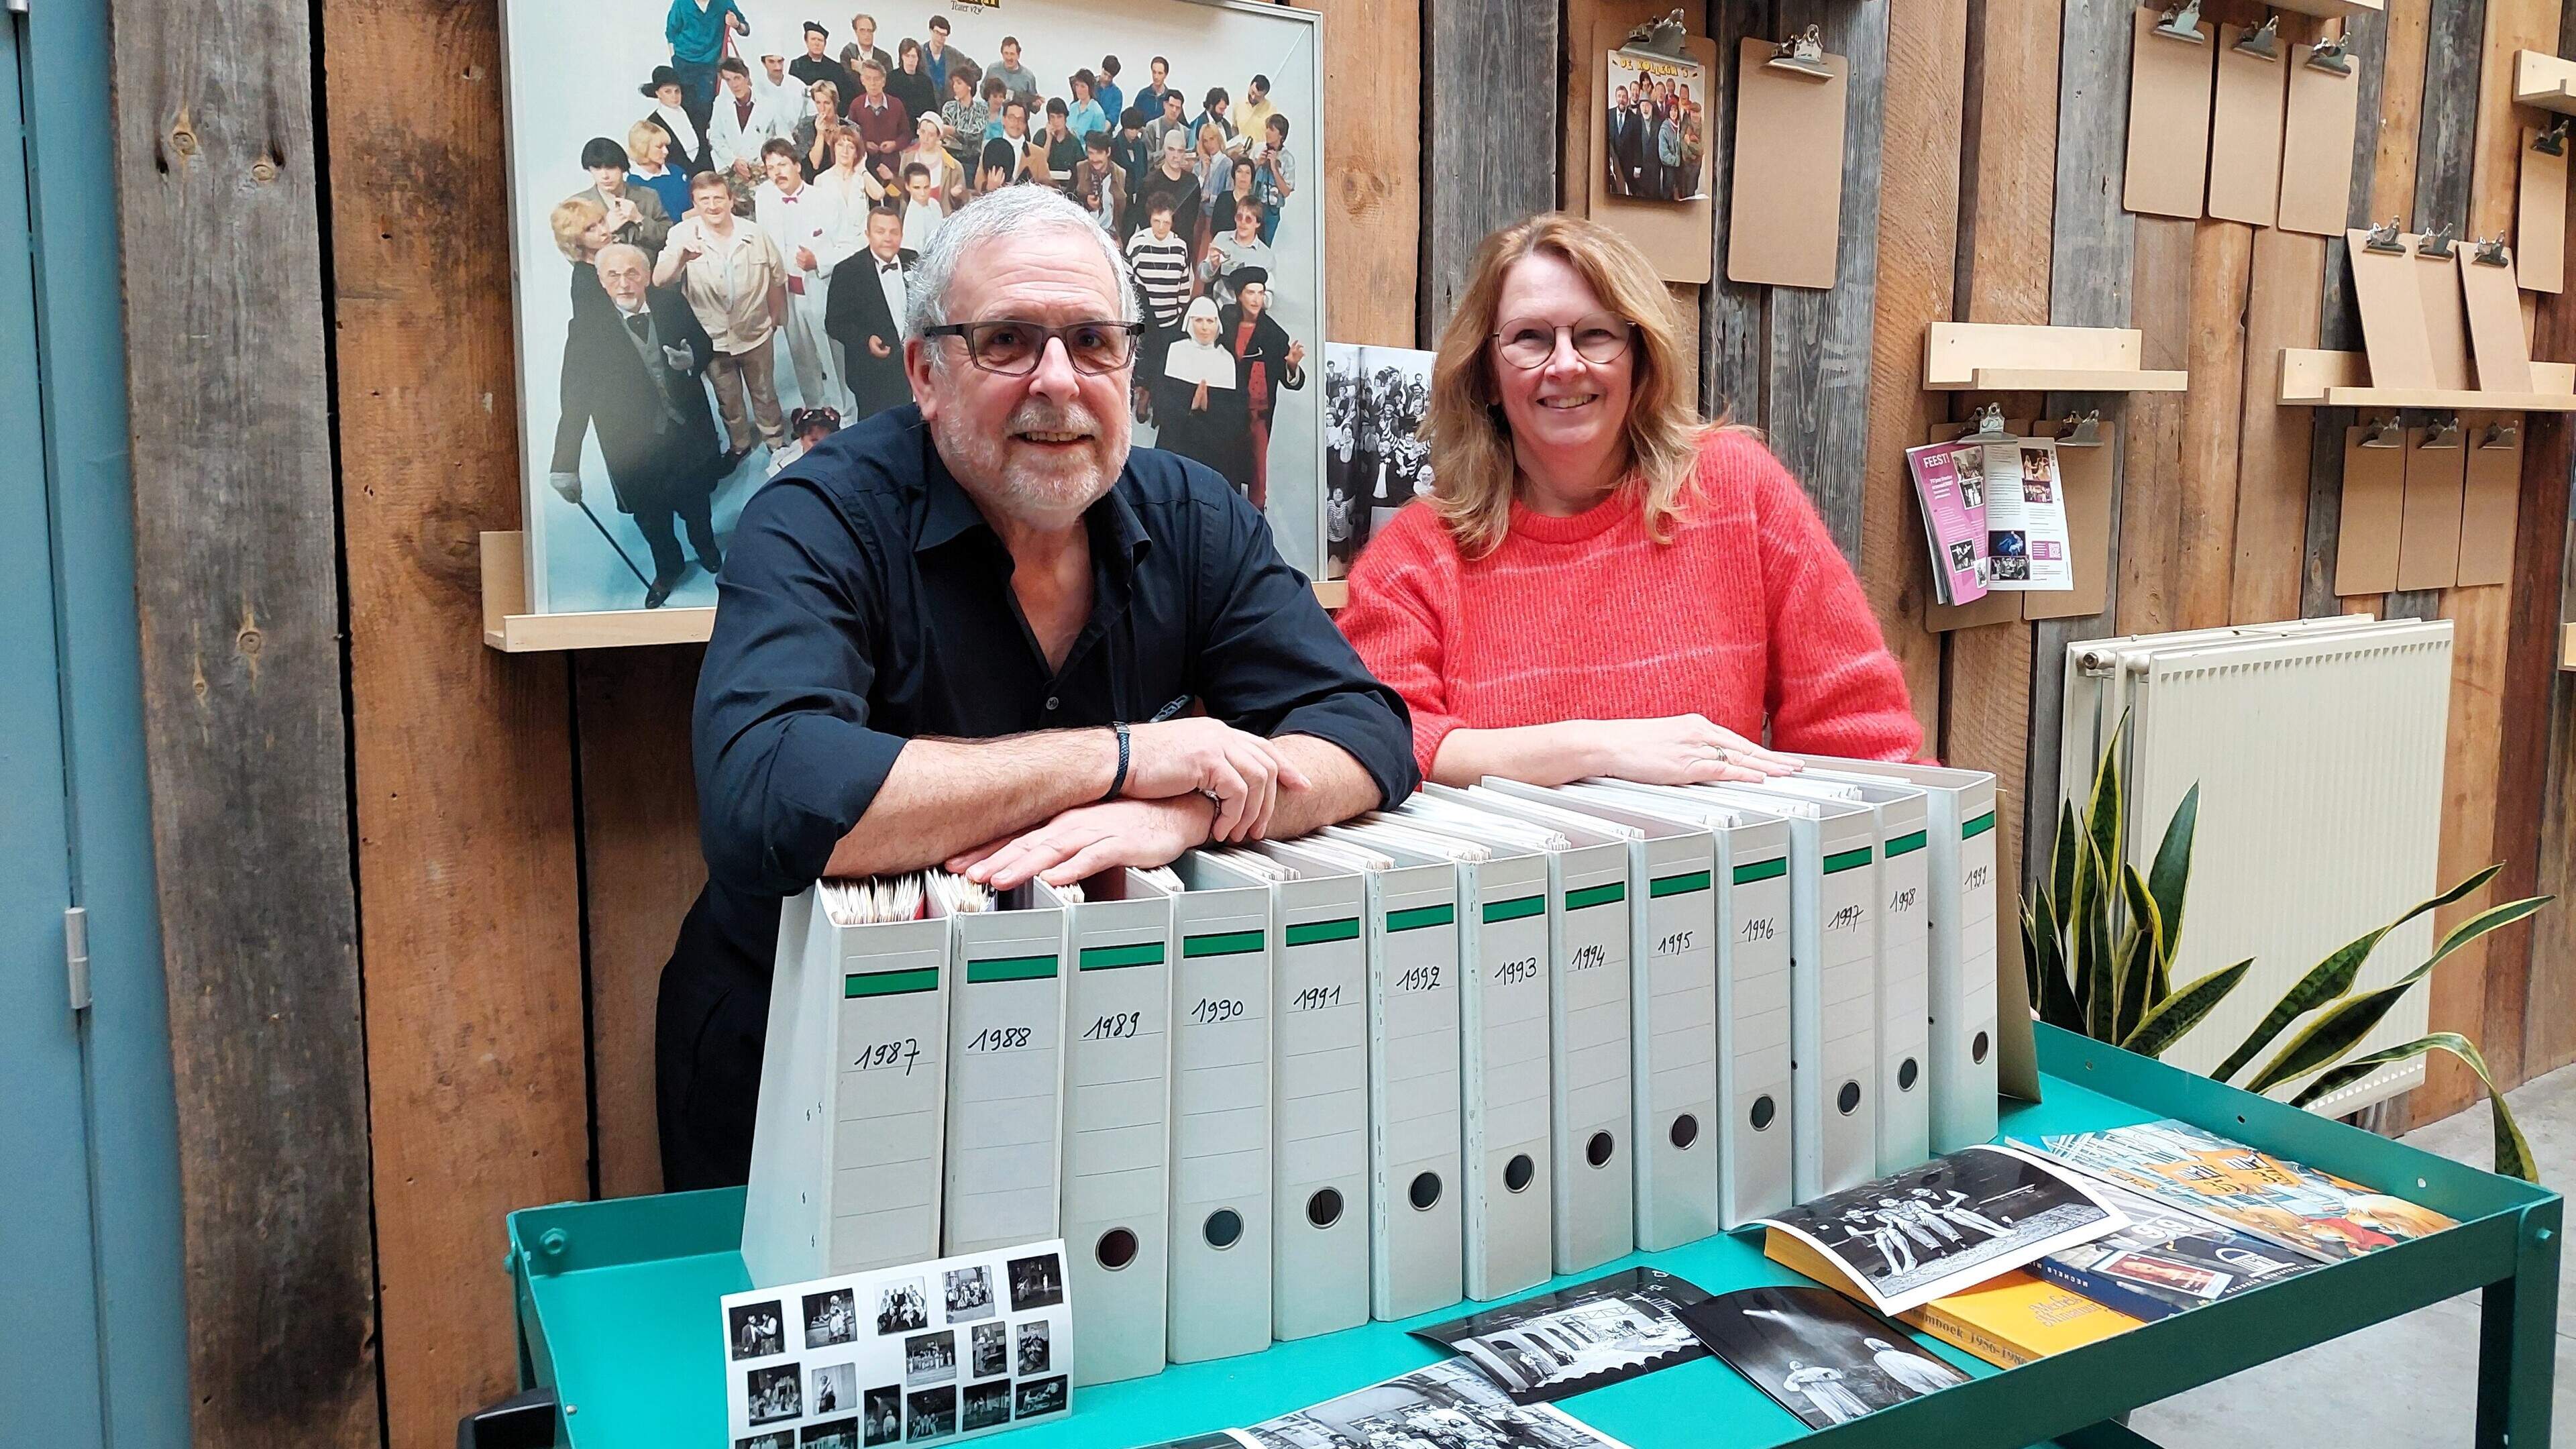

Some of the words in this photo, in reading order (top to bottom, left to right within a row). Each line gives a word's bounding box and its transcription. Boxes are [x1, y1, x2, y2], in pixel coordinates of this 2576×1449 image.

[1923, 452, 1950, 468] FEEST!
[1964, 864, 1988, 891] 1999
[1890, 888, 1916, 913] 1998
[1742, 917, 1774, 943] 1996
[1828, 905, 1864, 932] 1997
[1658, 931, 1693, 956] 1995
[1572, 945, 1605, 970] 1994
[1396, 966, 1440, 991] 1992
[1494, 957, 1537, 985] 1993
[1293, 985, 1341, 1010] 1991
[1191, 998, 1244, 1024] 1990
[1083, 1012, 1140, 1039] 1989
[967, 1027, 1032, 1052] 1988
[854, 1038, 920, 1076] 1987
